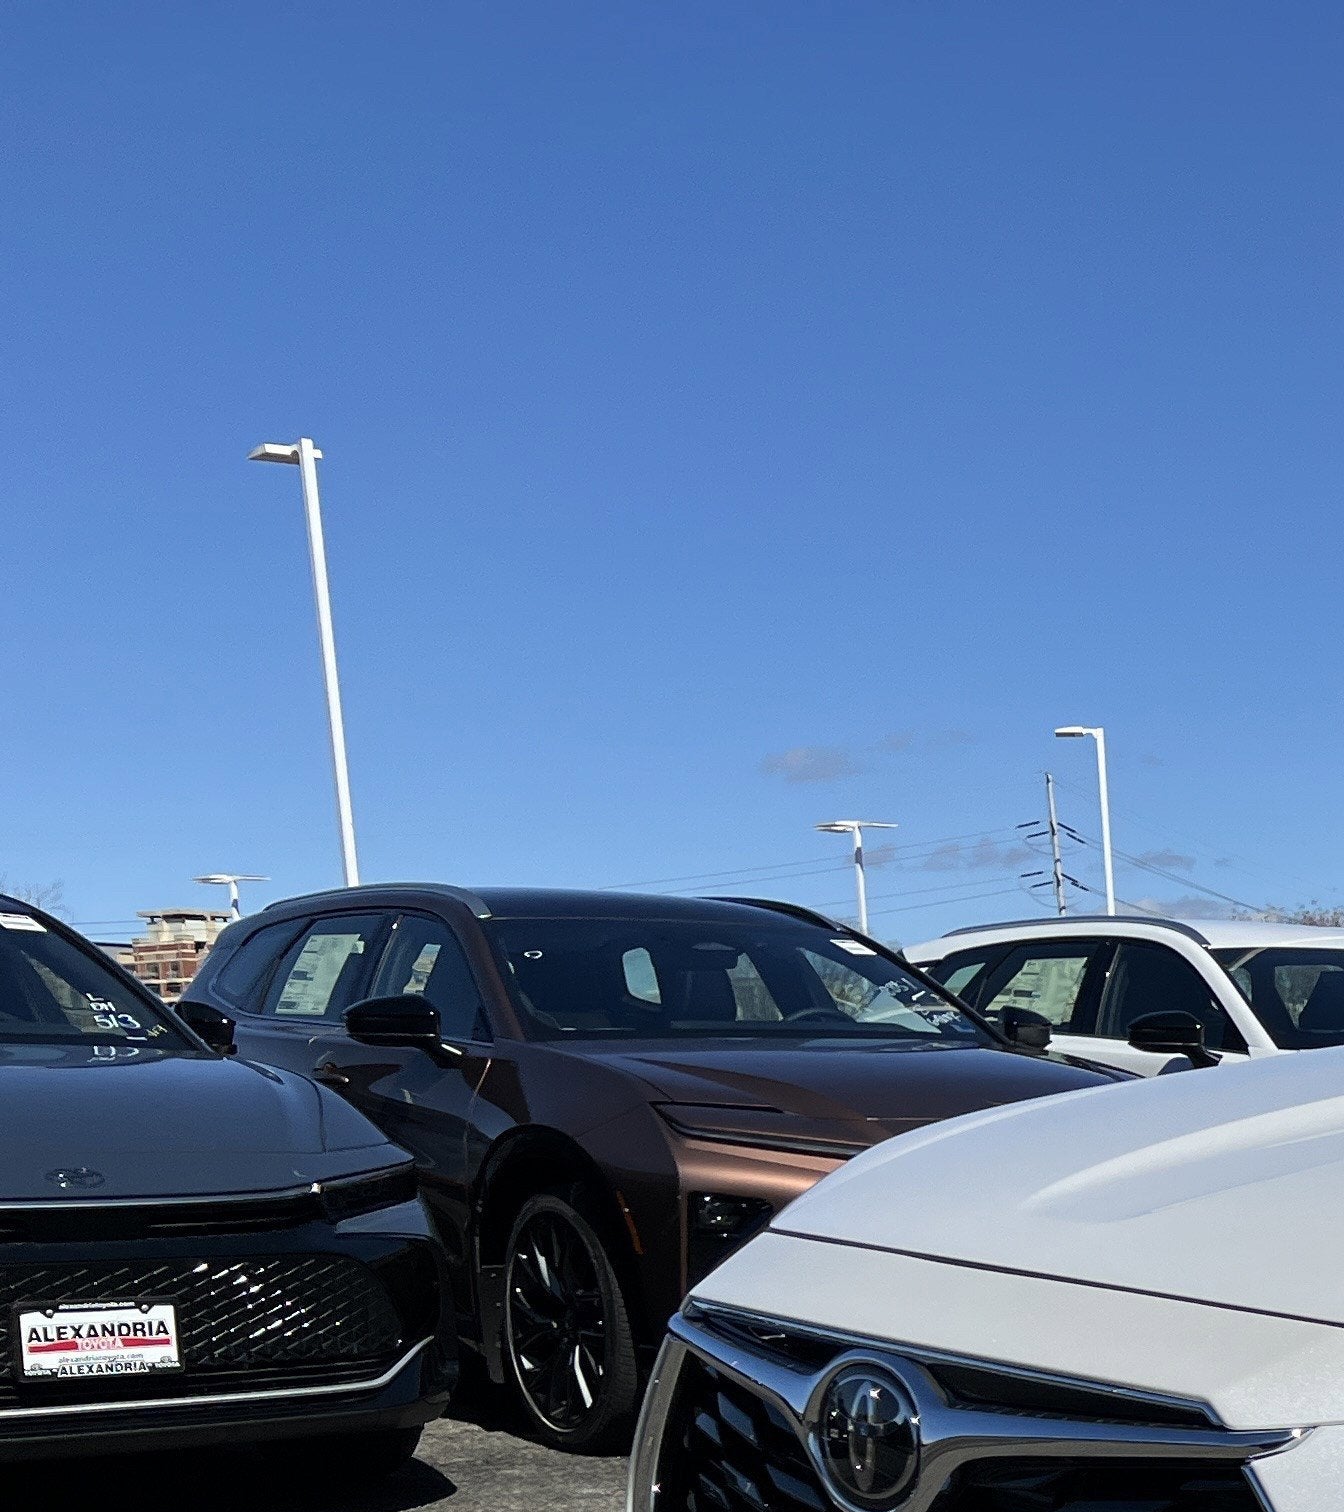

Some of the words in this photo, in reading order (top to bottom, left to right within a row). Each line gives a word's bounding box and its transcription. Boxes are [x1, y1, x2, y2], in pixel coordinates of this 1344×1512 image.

[28, 1321, 169, 1343] ALEXANDRIA
[78, 1337, 123, 1350] TOYOTA
[60, 1360, 147, 1376] ALEXANDRIA
